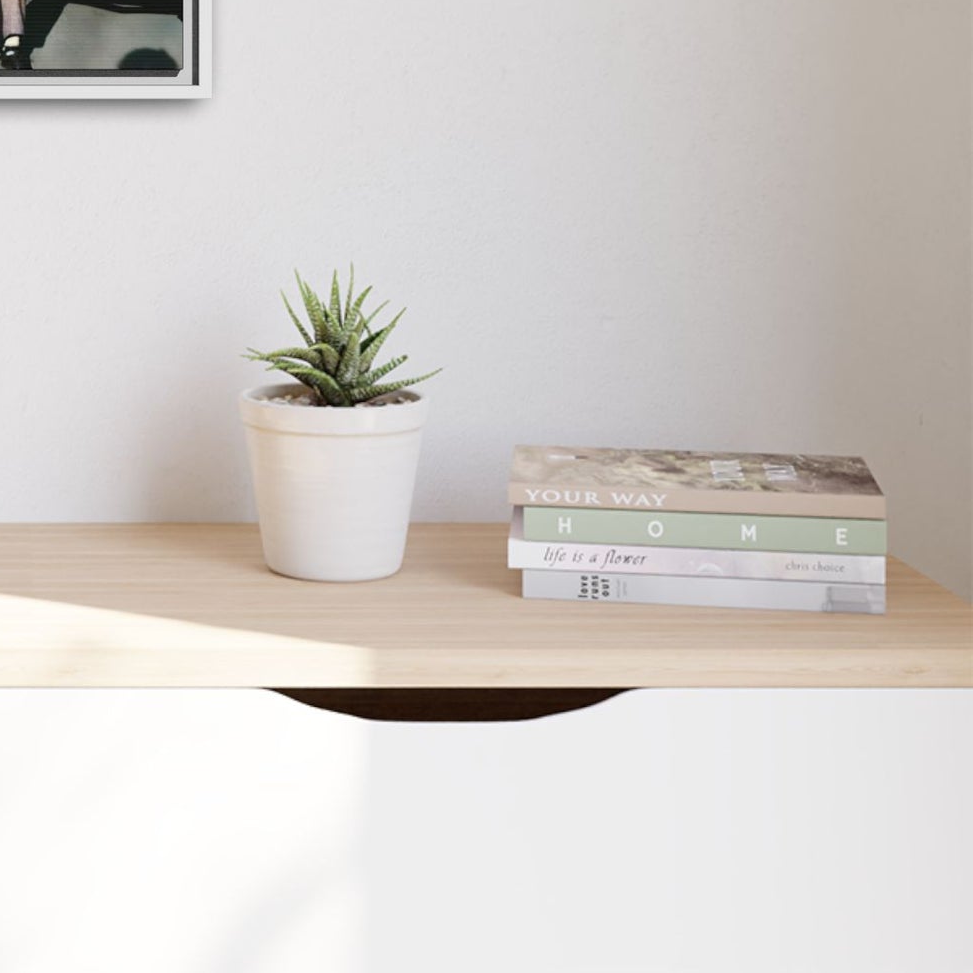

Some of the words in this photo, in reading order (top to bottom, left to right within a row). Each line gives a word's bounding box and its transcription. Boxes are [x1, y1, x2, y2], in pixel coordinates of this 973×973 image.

[525, 489, 600, 504] YOUR
[611, 492, 667, 506] WAY
[543, 546, 567, 567] life
[572, 549, 584, 563] is
[589, 553, 598, 563] a
[600, 549, 648, 569] flower
[785, 560, 809, 571] chris
[812, 561, 845, 573] choice
[578, 575, 589, 598] love
[591, 575, 599, 599] runs
[600, 578, 610, 597] out
